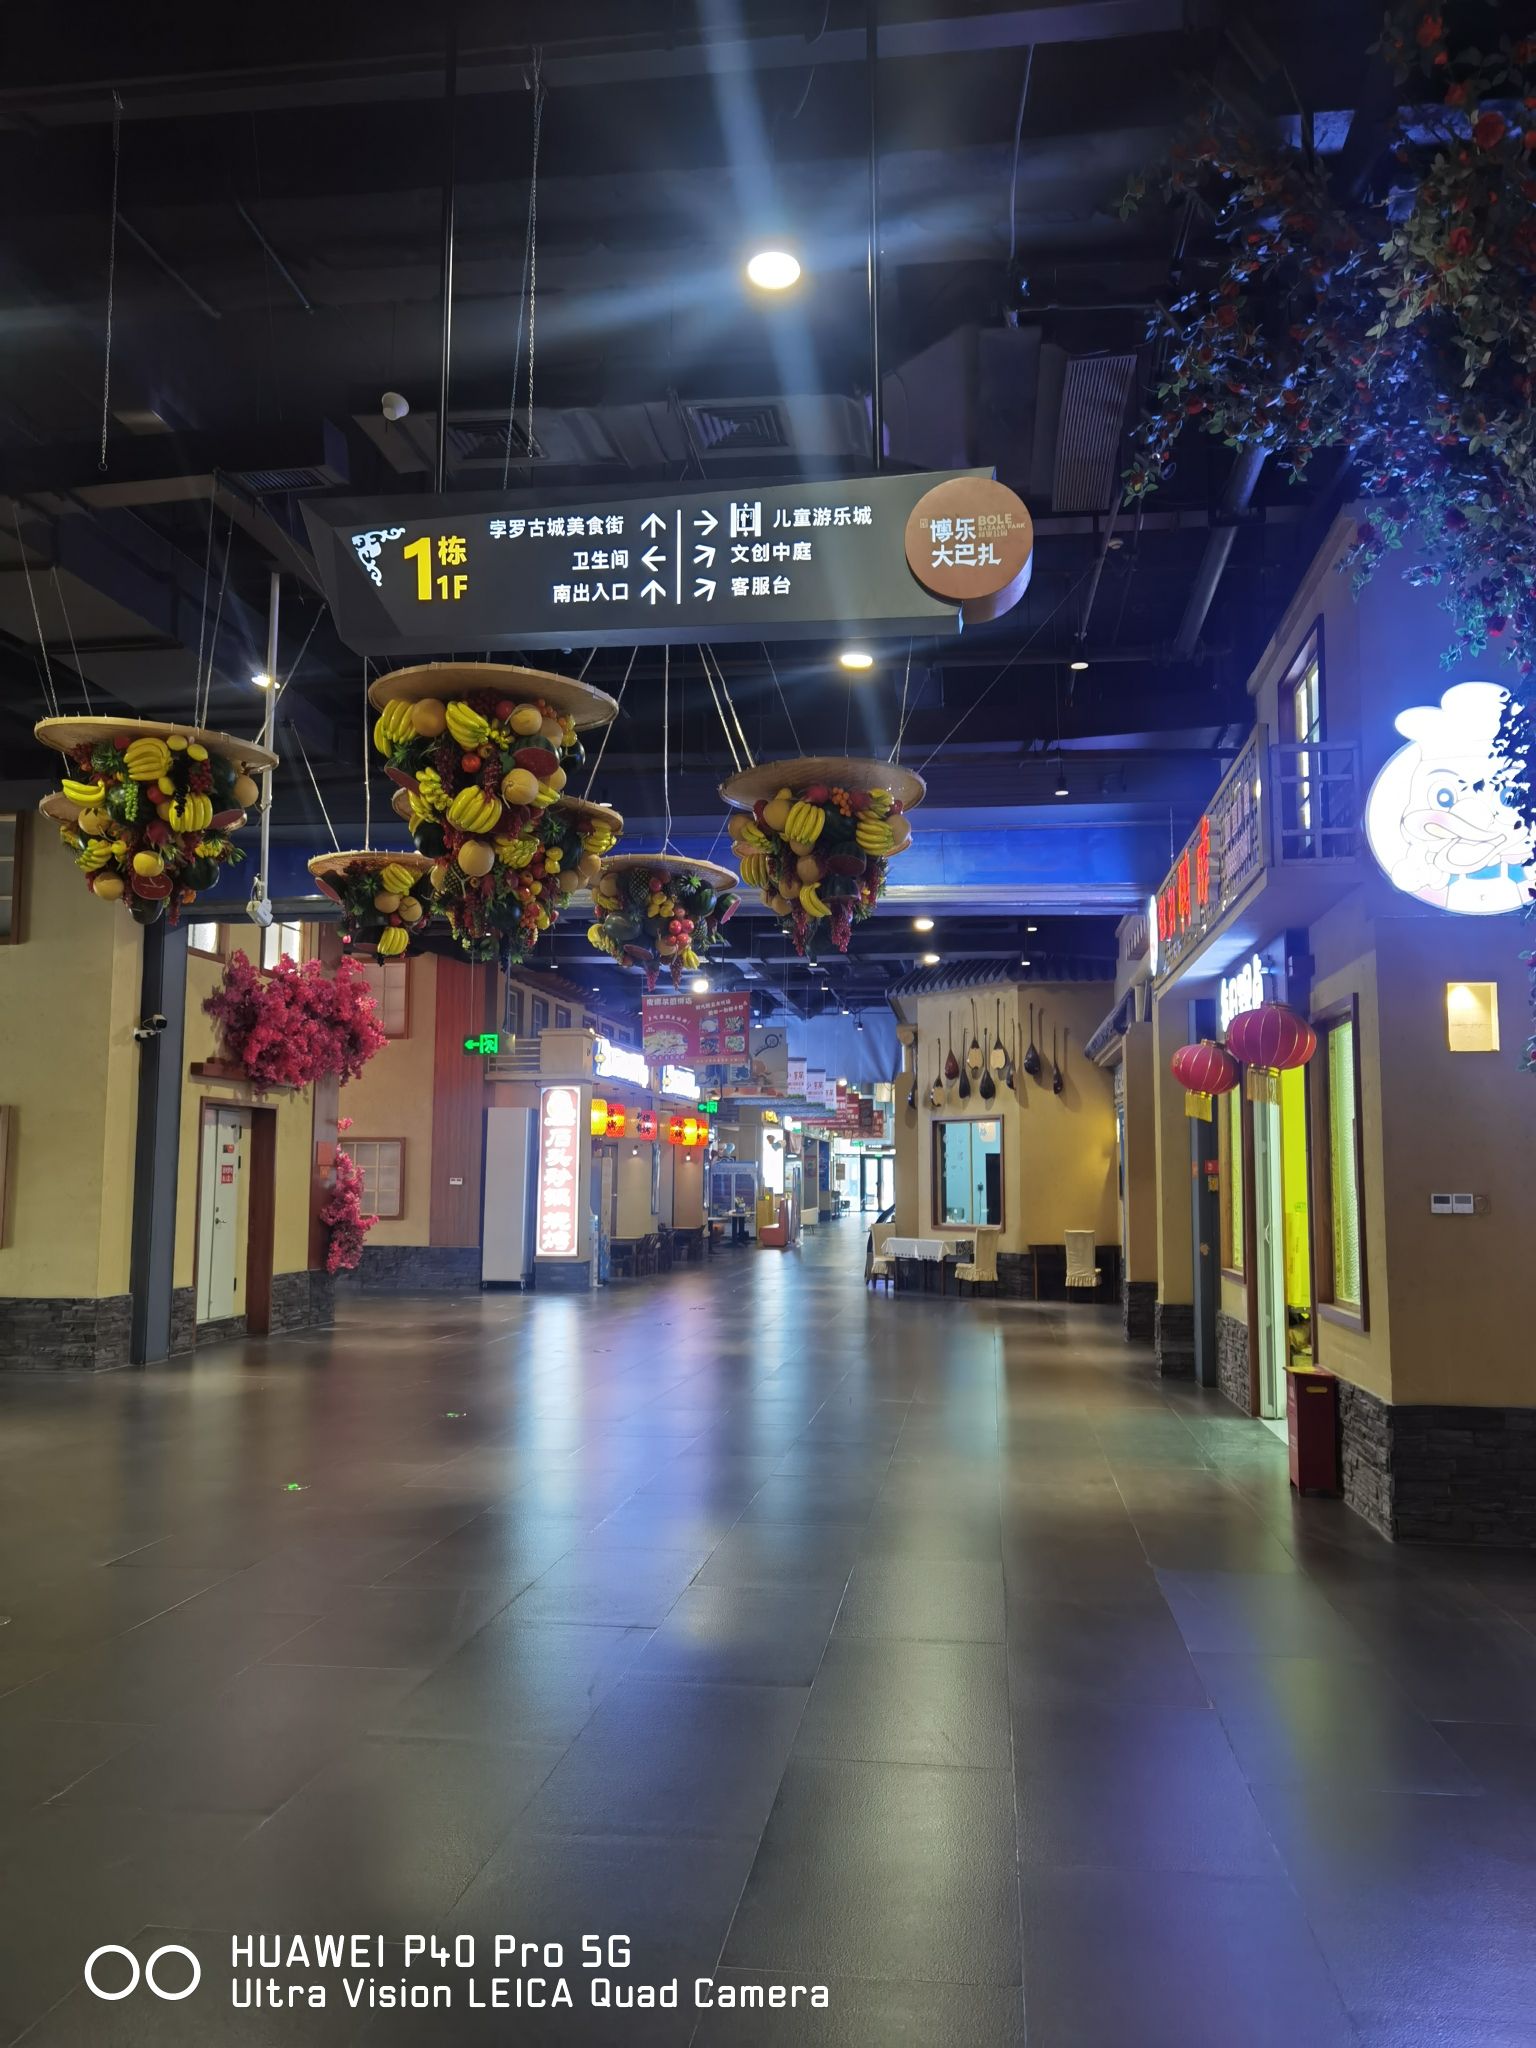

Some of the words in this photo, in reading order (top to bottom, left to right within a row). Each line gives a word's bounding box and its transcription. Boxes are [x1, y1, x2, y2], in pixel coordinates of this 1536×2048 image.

[773, 506, 872, 529] 儿童游乐城
[978, 513, 1012, 526] BOLE
[1007, 520, 1027, 530] PARK
[930, 518, 977, 543] 博乐
[438, 536, 467, 566] 栋
[572, 550, 629, 571] 卫生间
[731, 541, 812, 564] 文创中庭
[931, 542, 1002, 568] 大巴扎
[403, 537, 433, 601] 1
[437, 575, 468, 600] 1F
[553, 583, 629, 604] 南出入口
[731, 576, 791, 597] 客服台
